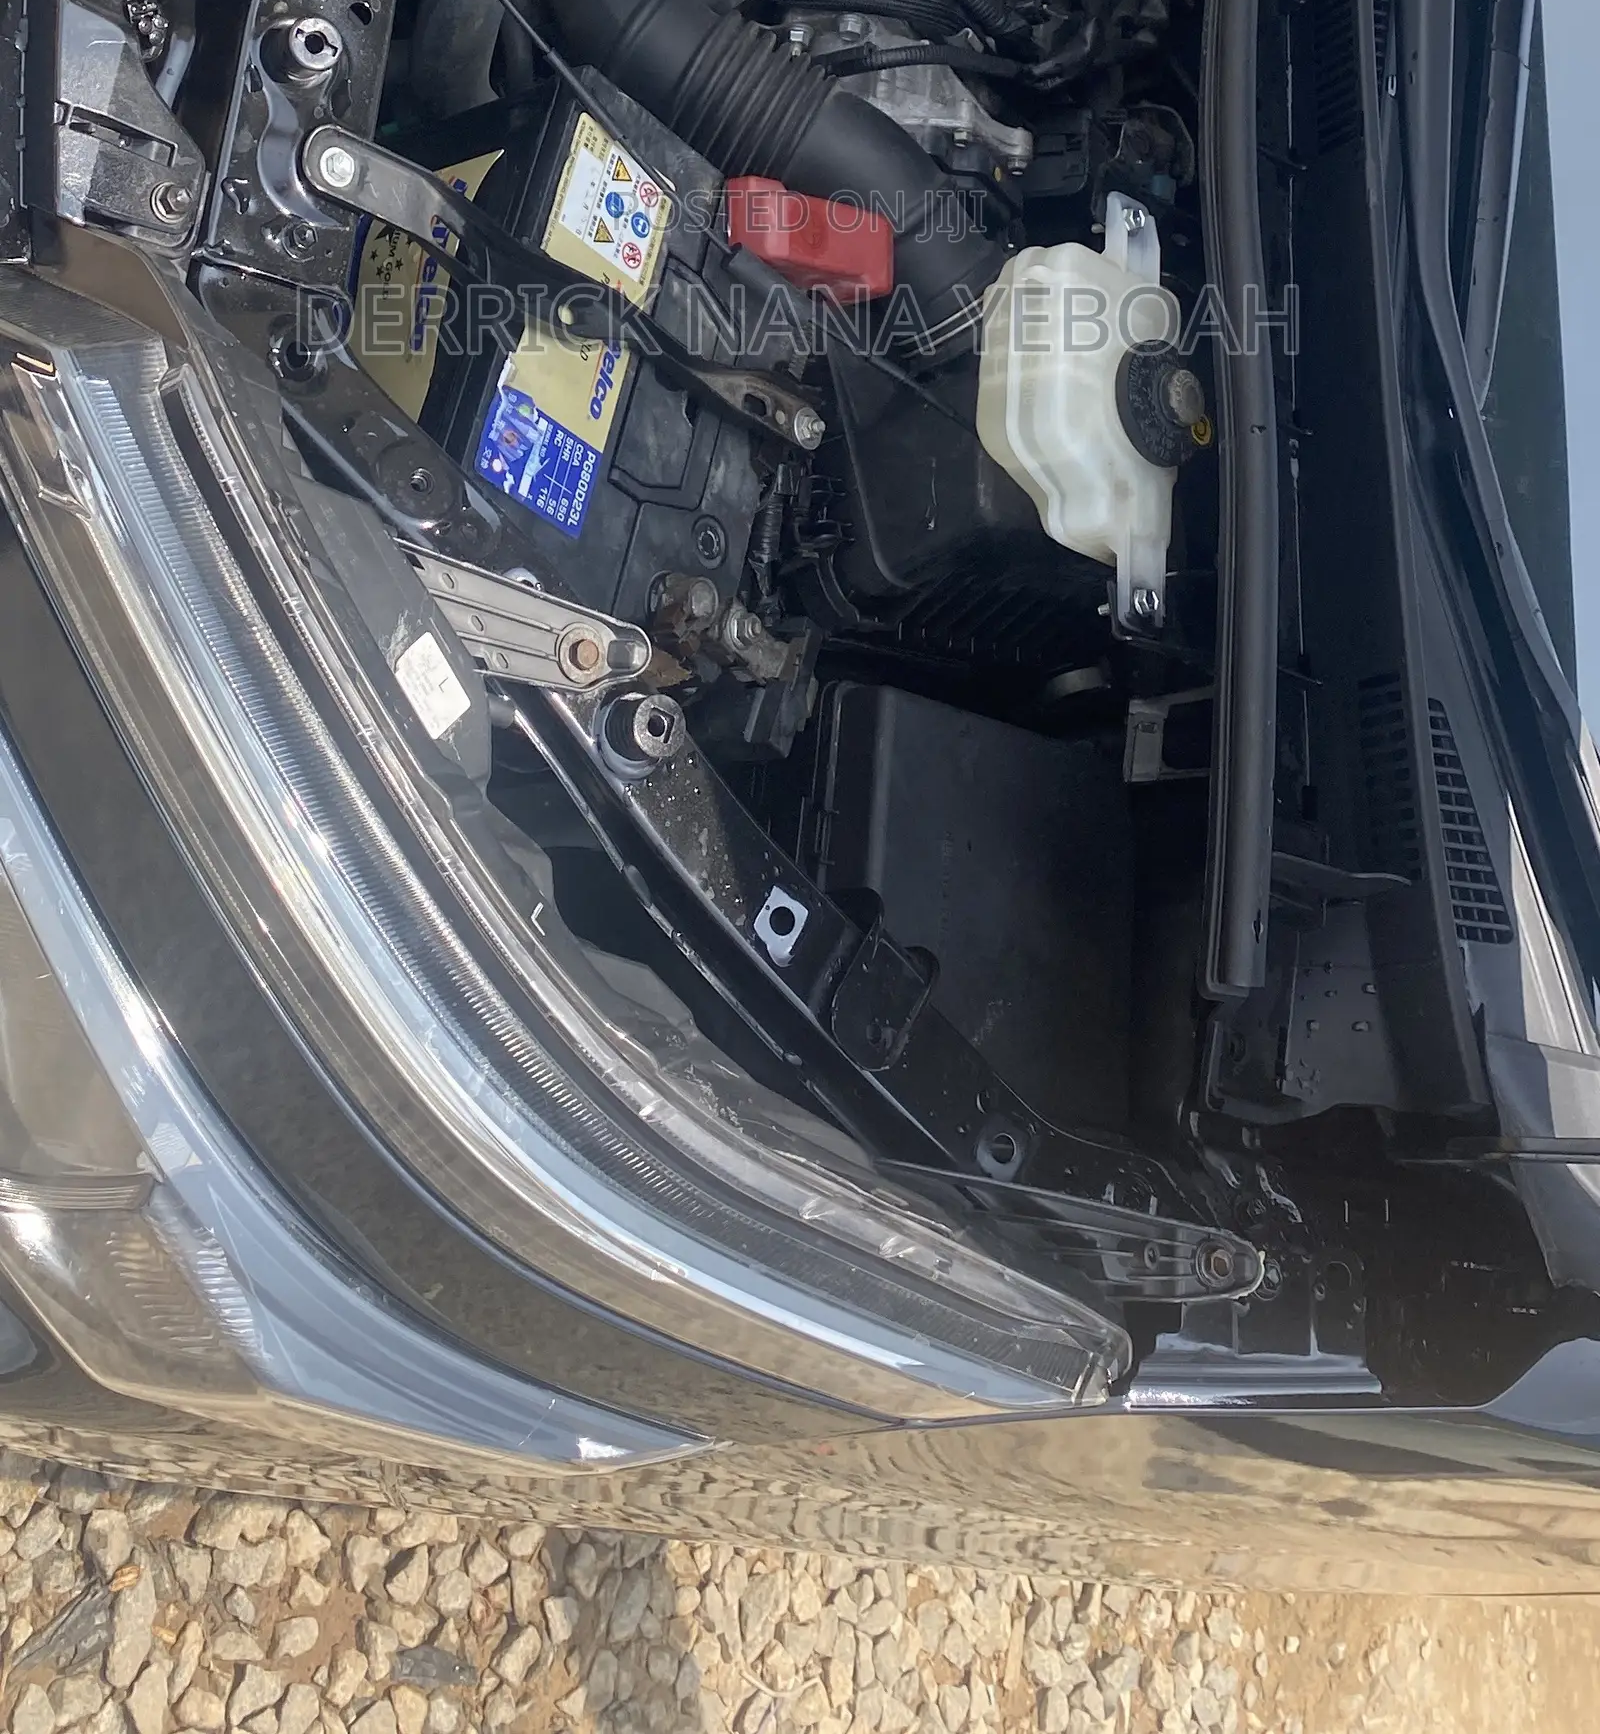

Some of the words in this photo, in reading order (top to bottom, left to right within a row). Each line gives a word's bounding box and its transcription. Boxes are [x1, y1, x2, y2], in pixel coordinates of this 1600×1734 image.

[554, 429, 565, 448] RC
[561, 436, 574, 463] 5HR
[571, 443, 584, 468] CCA
[536, 487, 549, 510] 116
[567, 450, 597, 527] PG80D23L
[546, 498, 557, 517] 56
[556, 498, 570, 523] 650
[438, 676, 449, 694] L
